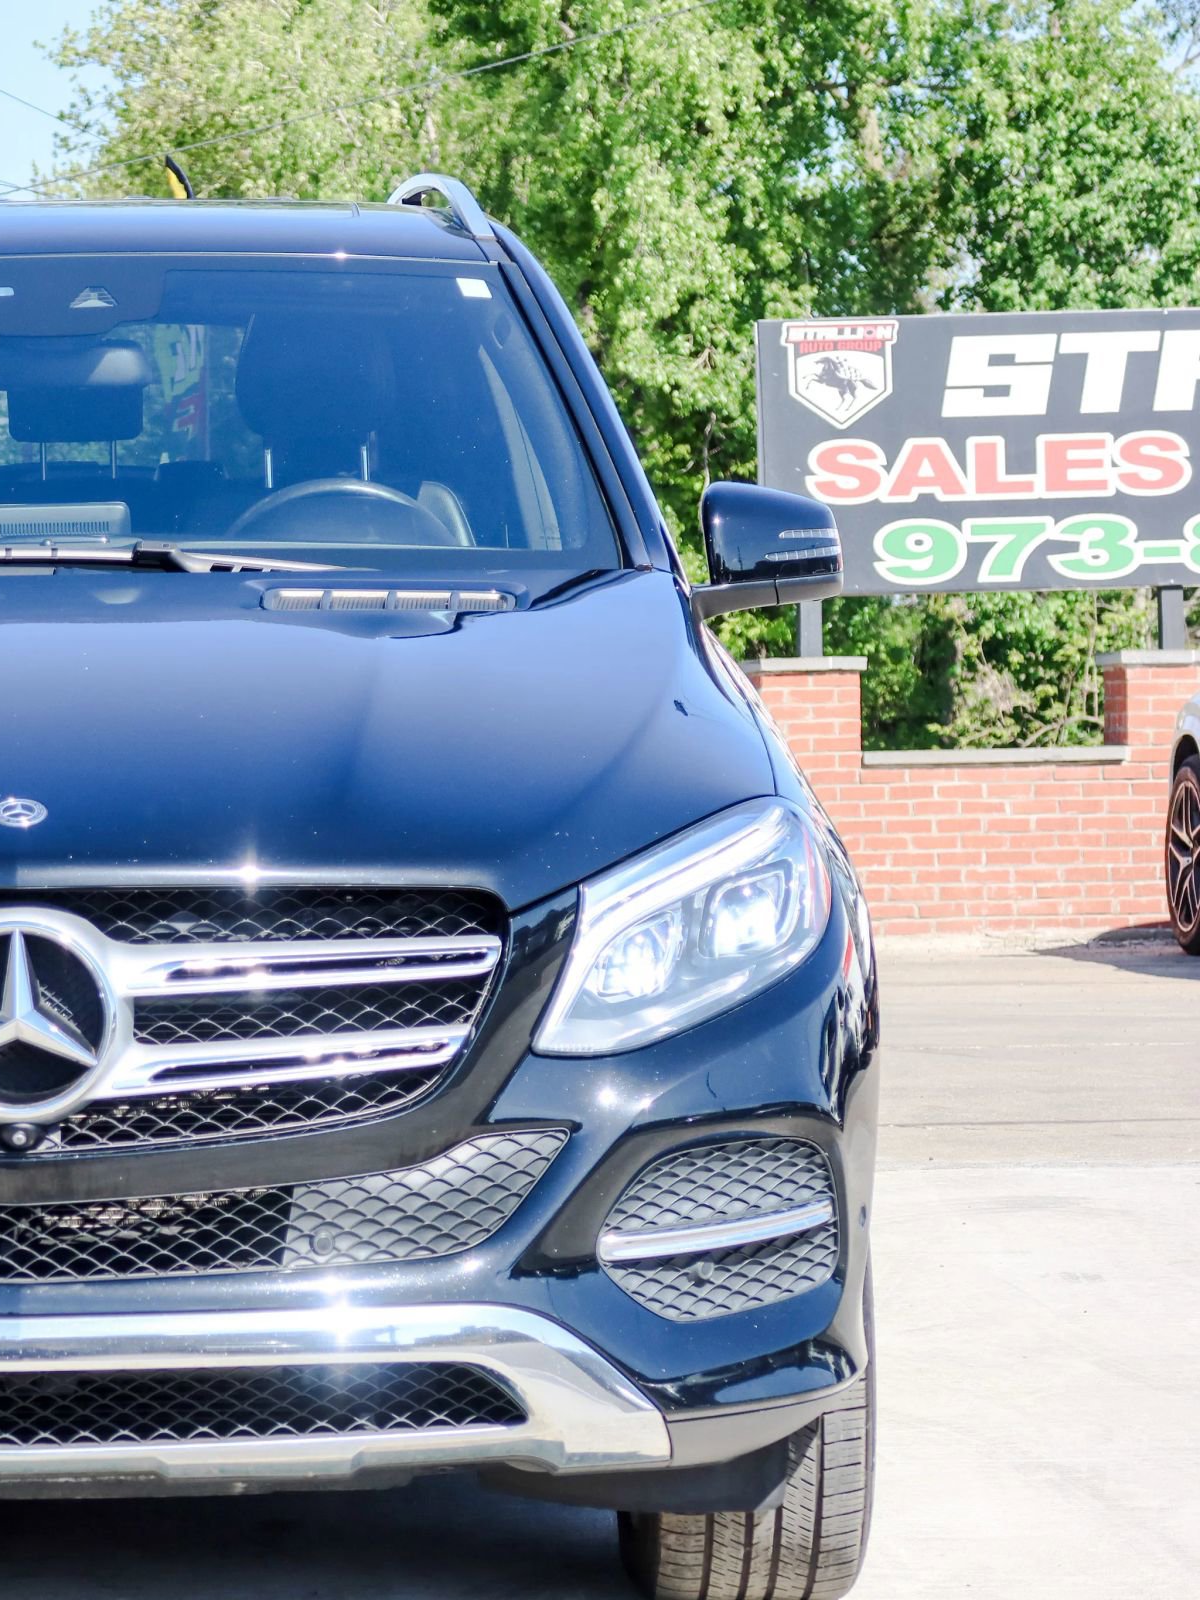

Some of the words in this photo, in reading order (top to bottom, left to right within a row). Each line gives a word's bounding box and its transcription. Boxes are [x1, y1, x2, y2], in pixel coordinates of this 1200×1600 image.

[799, 340, 834, 354] AUTO
[837, 340, 883, 352] GROUP
[805, 431, 1192, 505] SALES
[873, 513, 1200, 586] 973-
